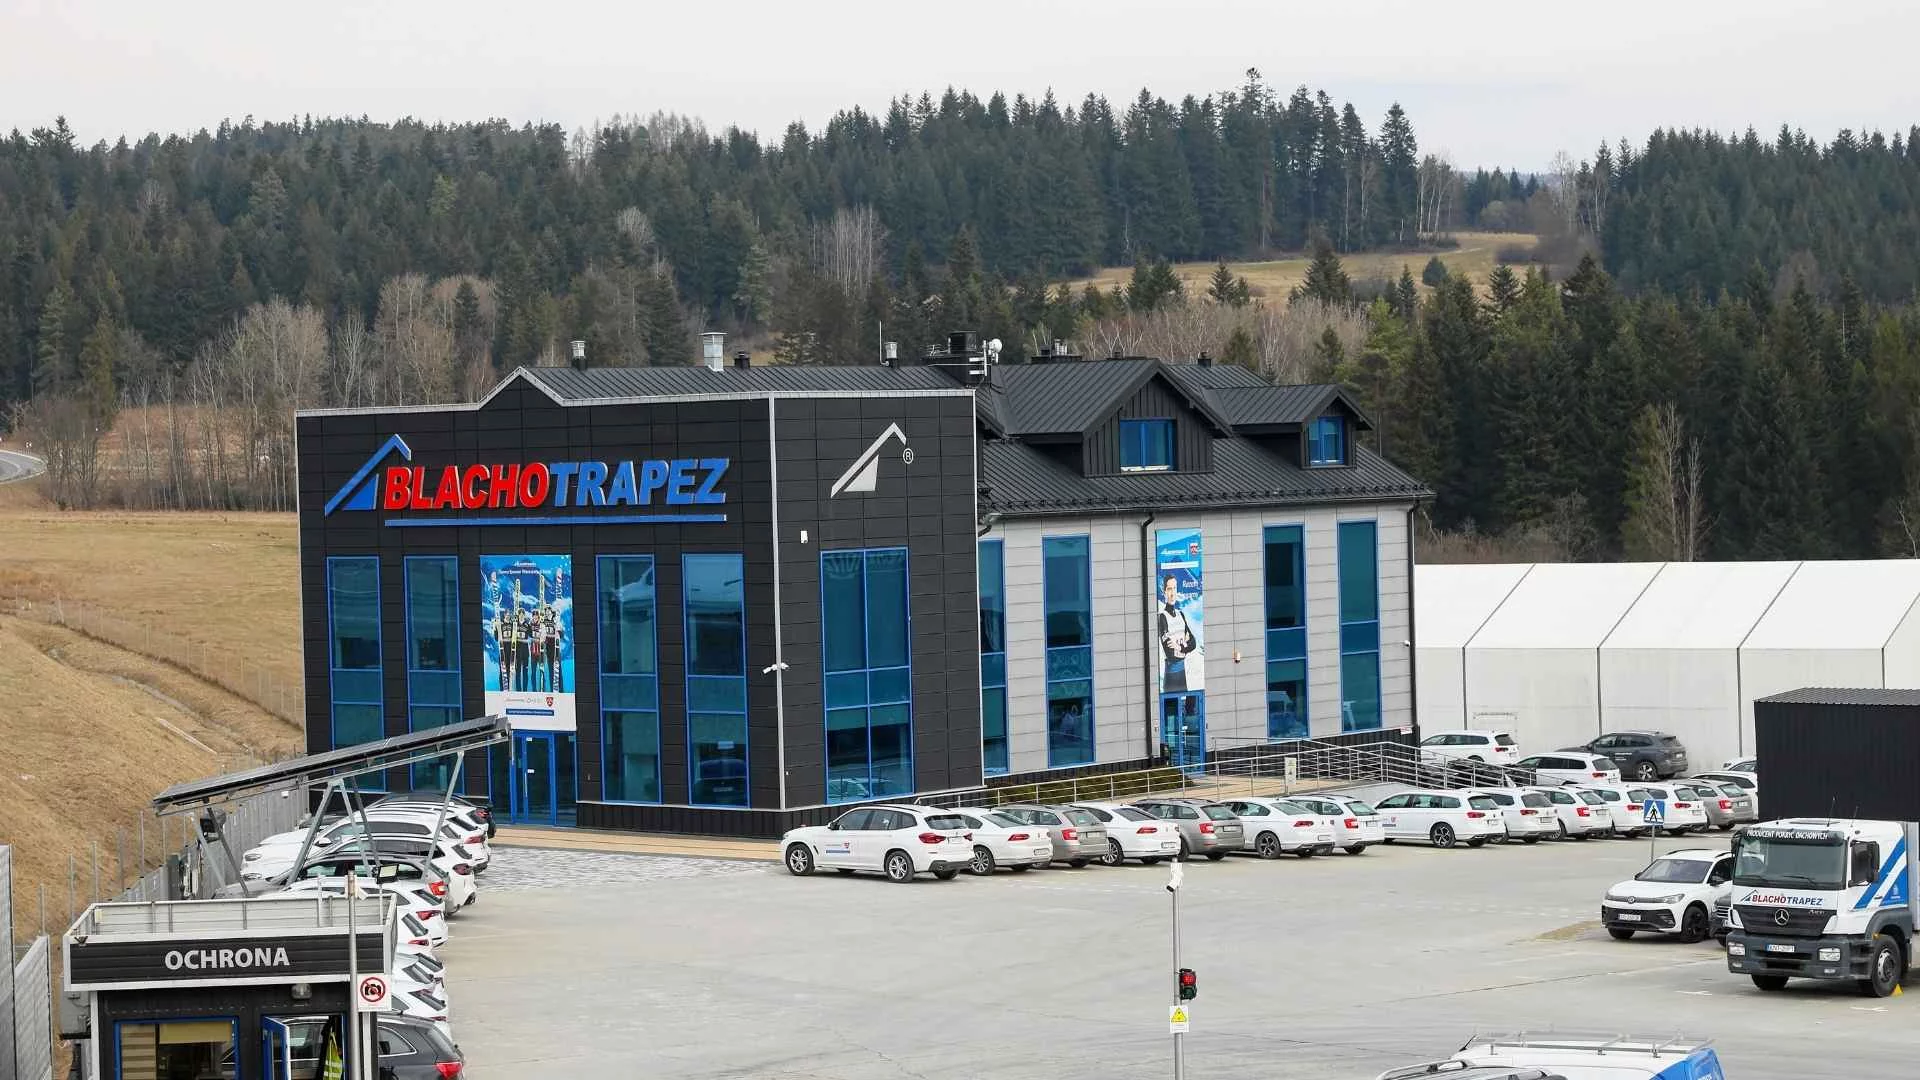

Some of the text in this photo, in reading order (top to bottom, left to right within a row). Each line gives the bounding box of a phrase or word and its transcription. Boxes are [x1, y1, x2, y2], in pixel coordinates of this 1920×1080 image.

[384, 458, 729, 510] BLACHOTRAPEZ
[1746, 830, 1775, 838] PRODUCENT
[1752, 894, 1824, 906] BLACHOTRAPEZ
[165, 947, 290, 970] OCHRONA
